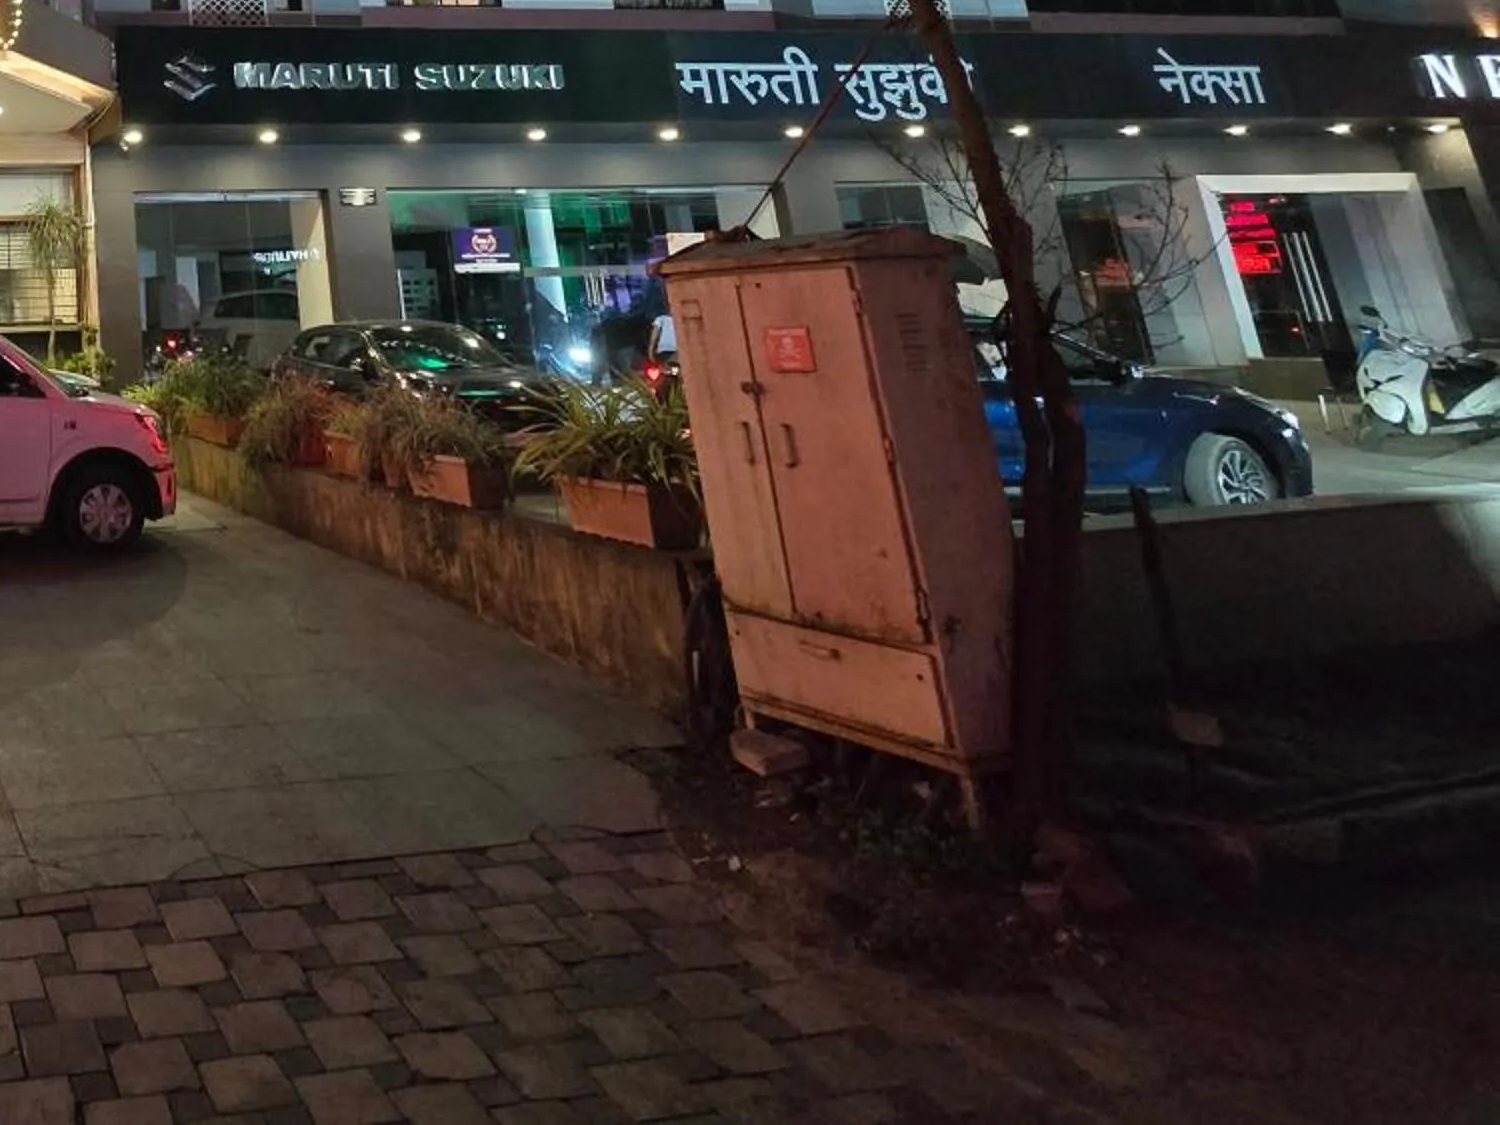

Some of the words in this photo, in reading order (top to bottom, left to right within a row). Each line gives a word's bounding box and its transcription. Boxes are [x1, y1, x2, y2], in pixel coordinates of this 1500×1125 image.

[232, 61, 399, 90] MARUTI
[414, 63, 565, 91] SUZUKI
[675, 46, 821, 106] मारुती
[1152, 46, 1267, 105] नेक्सा
